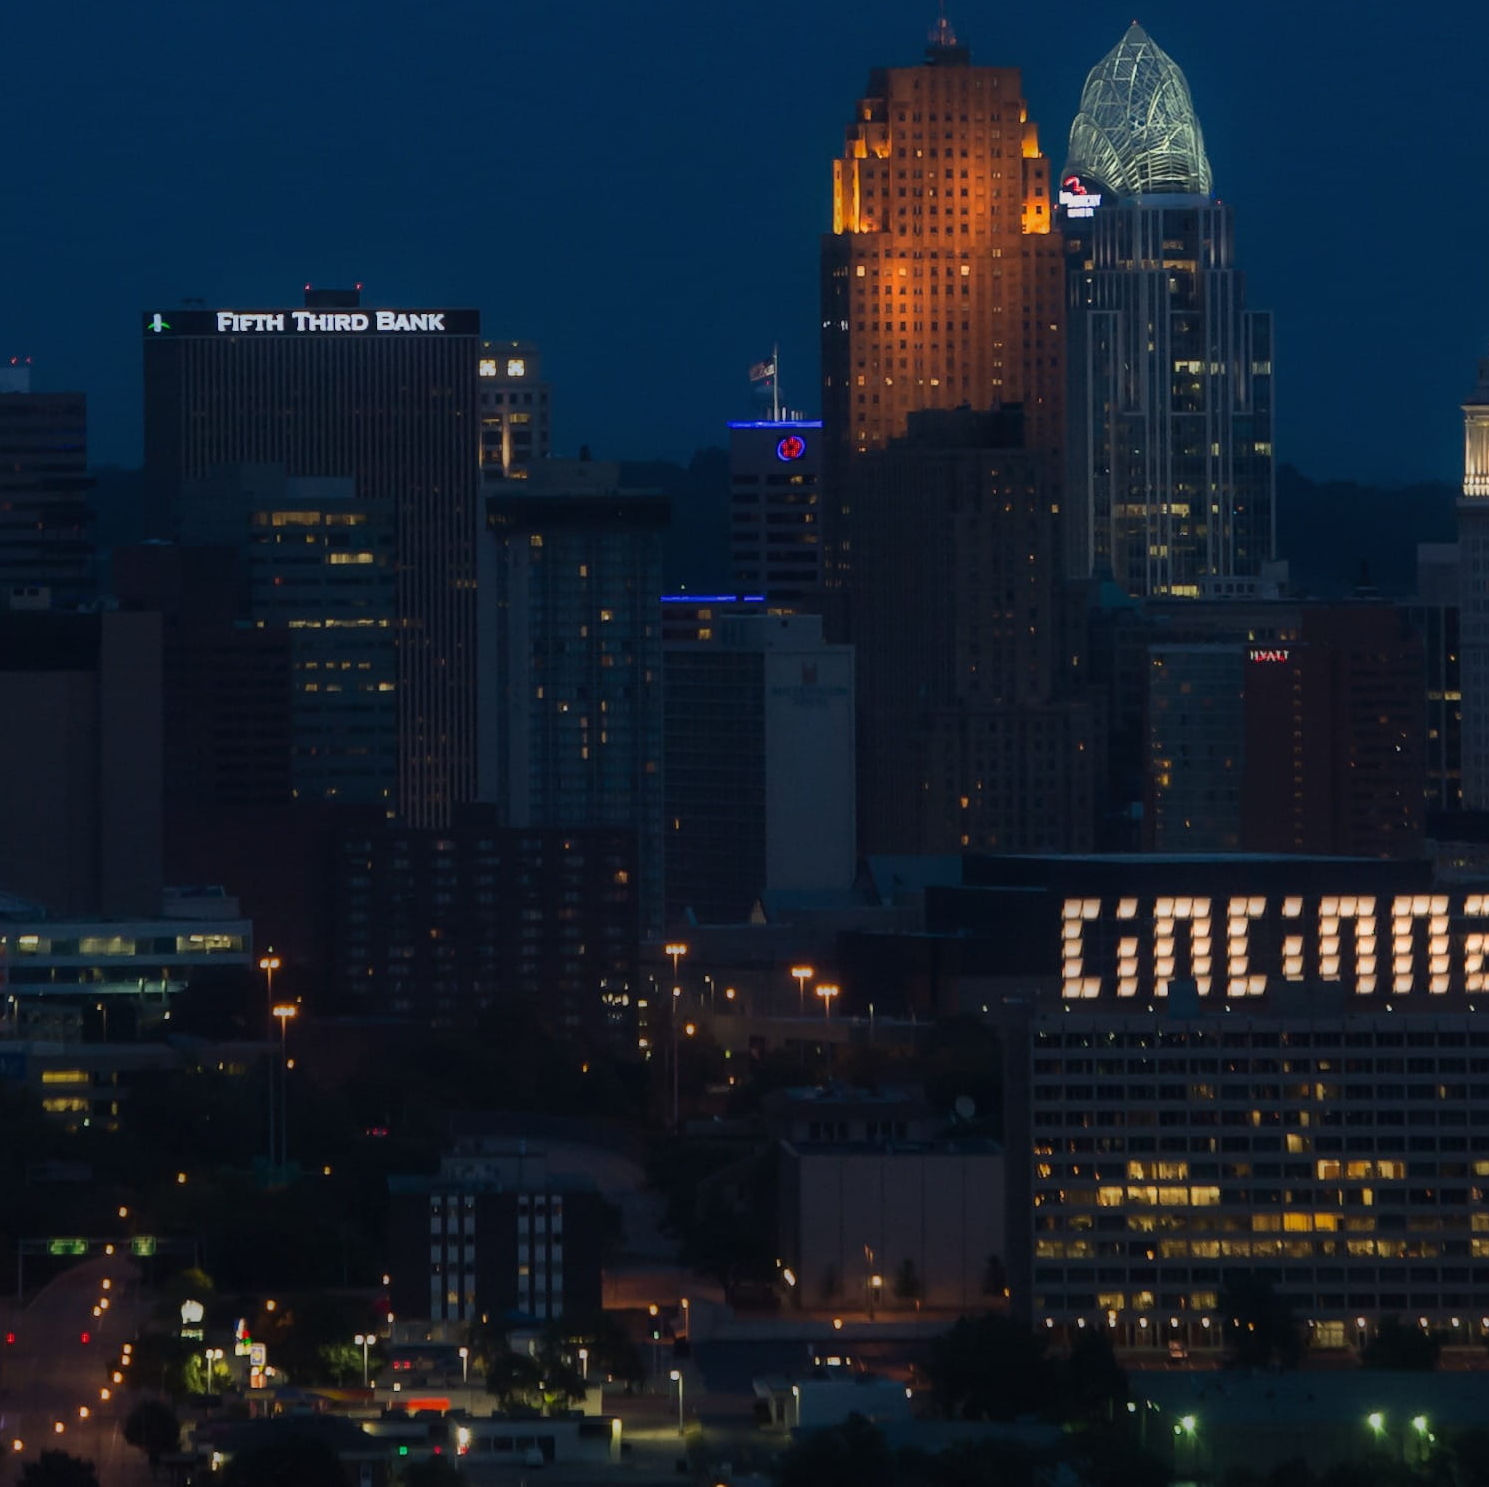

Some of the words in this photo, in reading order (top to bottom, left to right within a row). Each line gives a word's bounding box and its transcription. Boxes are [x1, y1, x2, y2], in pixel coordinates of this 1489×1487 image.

[217, 311, 285, 332] FIFTH
[292, 311, 369, 331] THIRD
[376, 311, 445, 331] BANK
